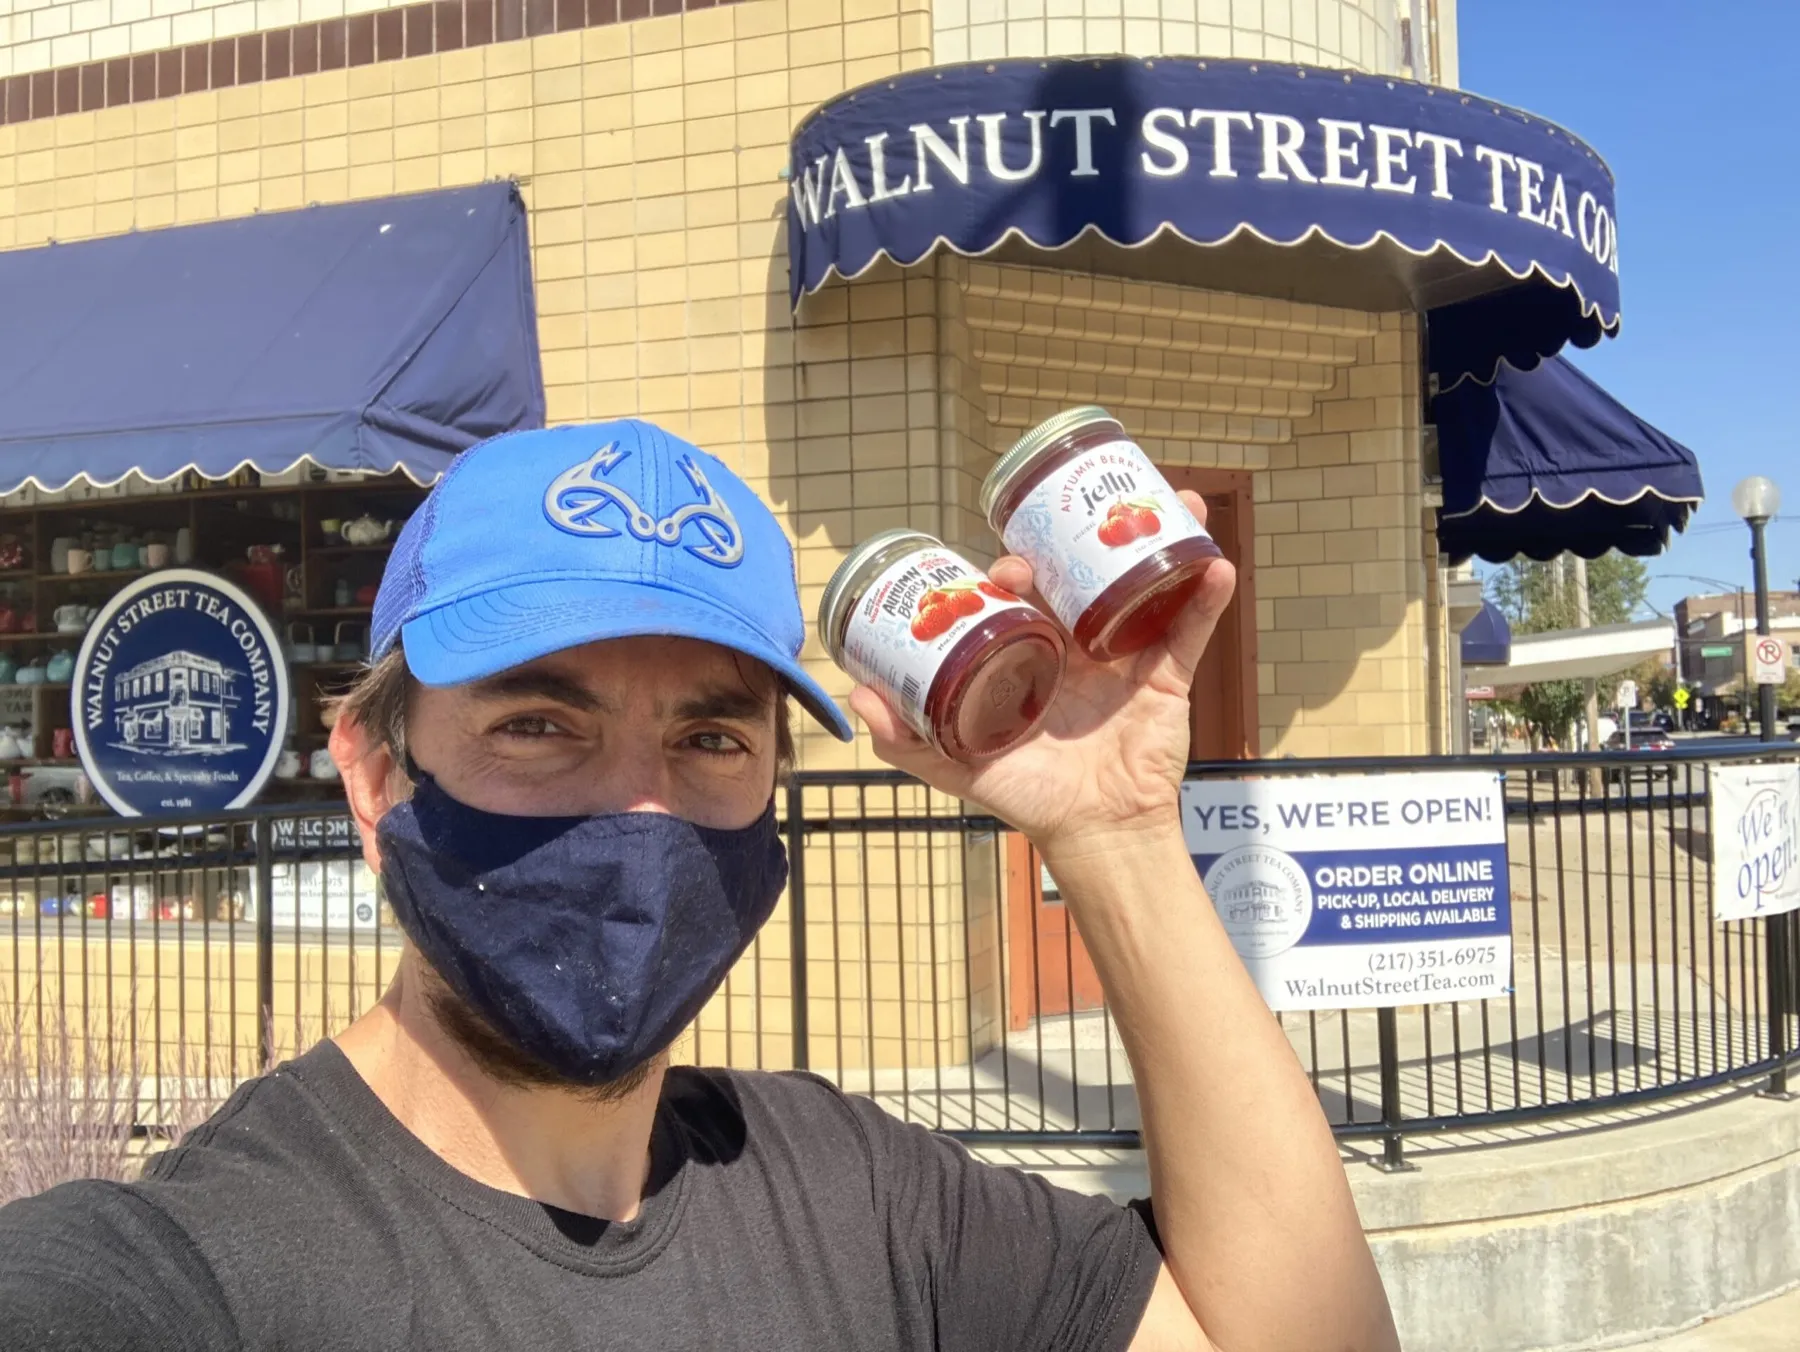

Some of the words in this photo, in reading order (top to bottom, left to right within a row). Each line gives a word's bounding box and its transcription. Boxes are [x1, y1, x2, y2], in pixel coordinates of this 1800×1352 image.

[791, 107, 1116, 232] WALNUT
[1141, 107, 1462, 199] STREET
[1475, 144, 1575, 240] TEA
[1060, 458, 1096, 513] AUTUMN
[1100, 455, 1143, 473] BERRY
[1080, 471, 1136, 516] jelly
[882, 566, 922, 617] AUTUMN
[928, 564, 967, 588] JAM
[897, 579, 927, 620] BERRY
[86, 628, 122, 731] WALNUT
[117, 589, 190, 634] STREET
[194, 591, 231, 626] TEA
[231, 618, 272, 737] COMPANY
[213, 770, 239, 782] Foods
[1194, 804, 1270, 835] YES,
[1277, 800, 1390, 829] WE'RE
[1401, 796, 1492, 825] OPEN!
[1223, 854, 1260, 873] STREET
[1263, 854, 1281, 870] TEA
[1315, 864, 1403, 889] ORDER
[1409, 860, 1494, 885] ONLINE
[1738, 816, 1798, 911] open!
[1317, 893, 1381, 909] PICK-UP,
[1384, 890, 1429, 908] LOCAL
[1432, 887, 1495, 905] DELIVERY
[1340, 915, 1352, 929] &
[1354, 911, 1421, 928] SHIPPING
[1424, 907, 1497, 926] AVAILABLE
[1285, 972, 1496, 997] WalnutStreetTea.com
